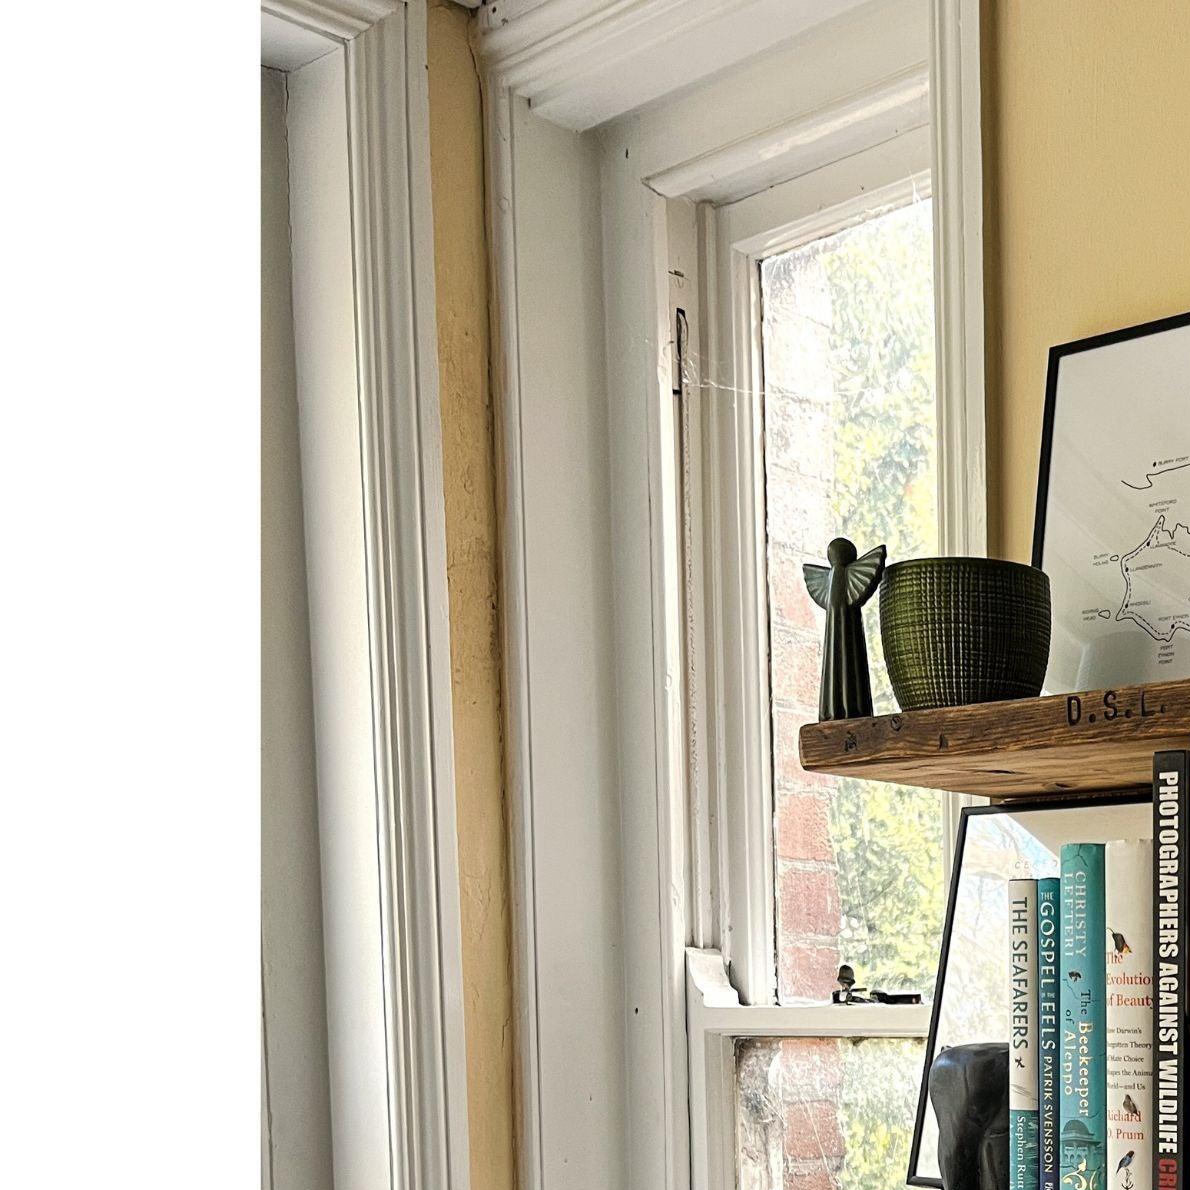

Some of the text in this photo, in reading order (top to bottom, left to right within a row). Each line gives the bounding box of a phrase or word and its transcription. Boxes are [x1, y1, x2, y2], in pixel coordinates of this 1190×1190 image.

[1041, 892, 1054, 900] THE
[1159, 771, 1179, 958] PHOTOGRAPHERS
[1040, 902, 1055, 988] GOSPEL
[1063, 873, 1074, 956] LEFTERI
[1075, 871, 1087, 957] CHRISTY
[1013, 897, 1028, 1049] THE SEAFARERS
[1106, 972, 1154, 985] Evolutio
[1159, 962, 1179, 1055] AGAINST
[1042, 1002, 1056, 1050] EELS
[1062, 1009, 1076, 1095] of Aleppo
[1075, 990, 1093, 1116] The Beekeeper
[1130, 1041, 1152, 1049] Theory
[1122, 1068, 1131, 1076] the
[1158, 1058, 1178, 1154] WILDLIFE
[1015, 1116, 1026, 1159] Stephen
[1044, 1057, 1053, 1173] PATRIK SVENSSON
[1116, 1129, 1144, 1140] Prum
[1017, 1163, 1026, 1189] Rutt
